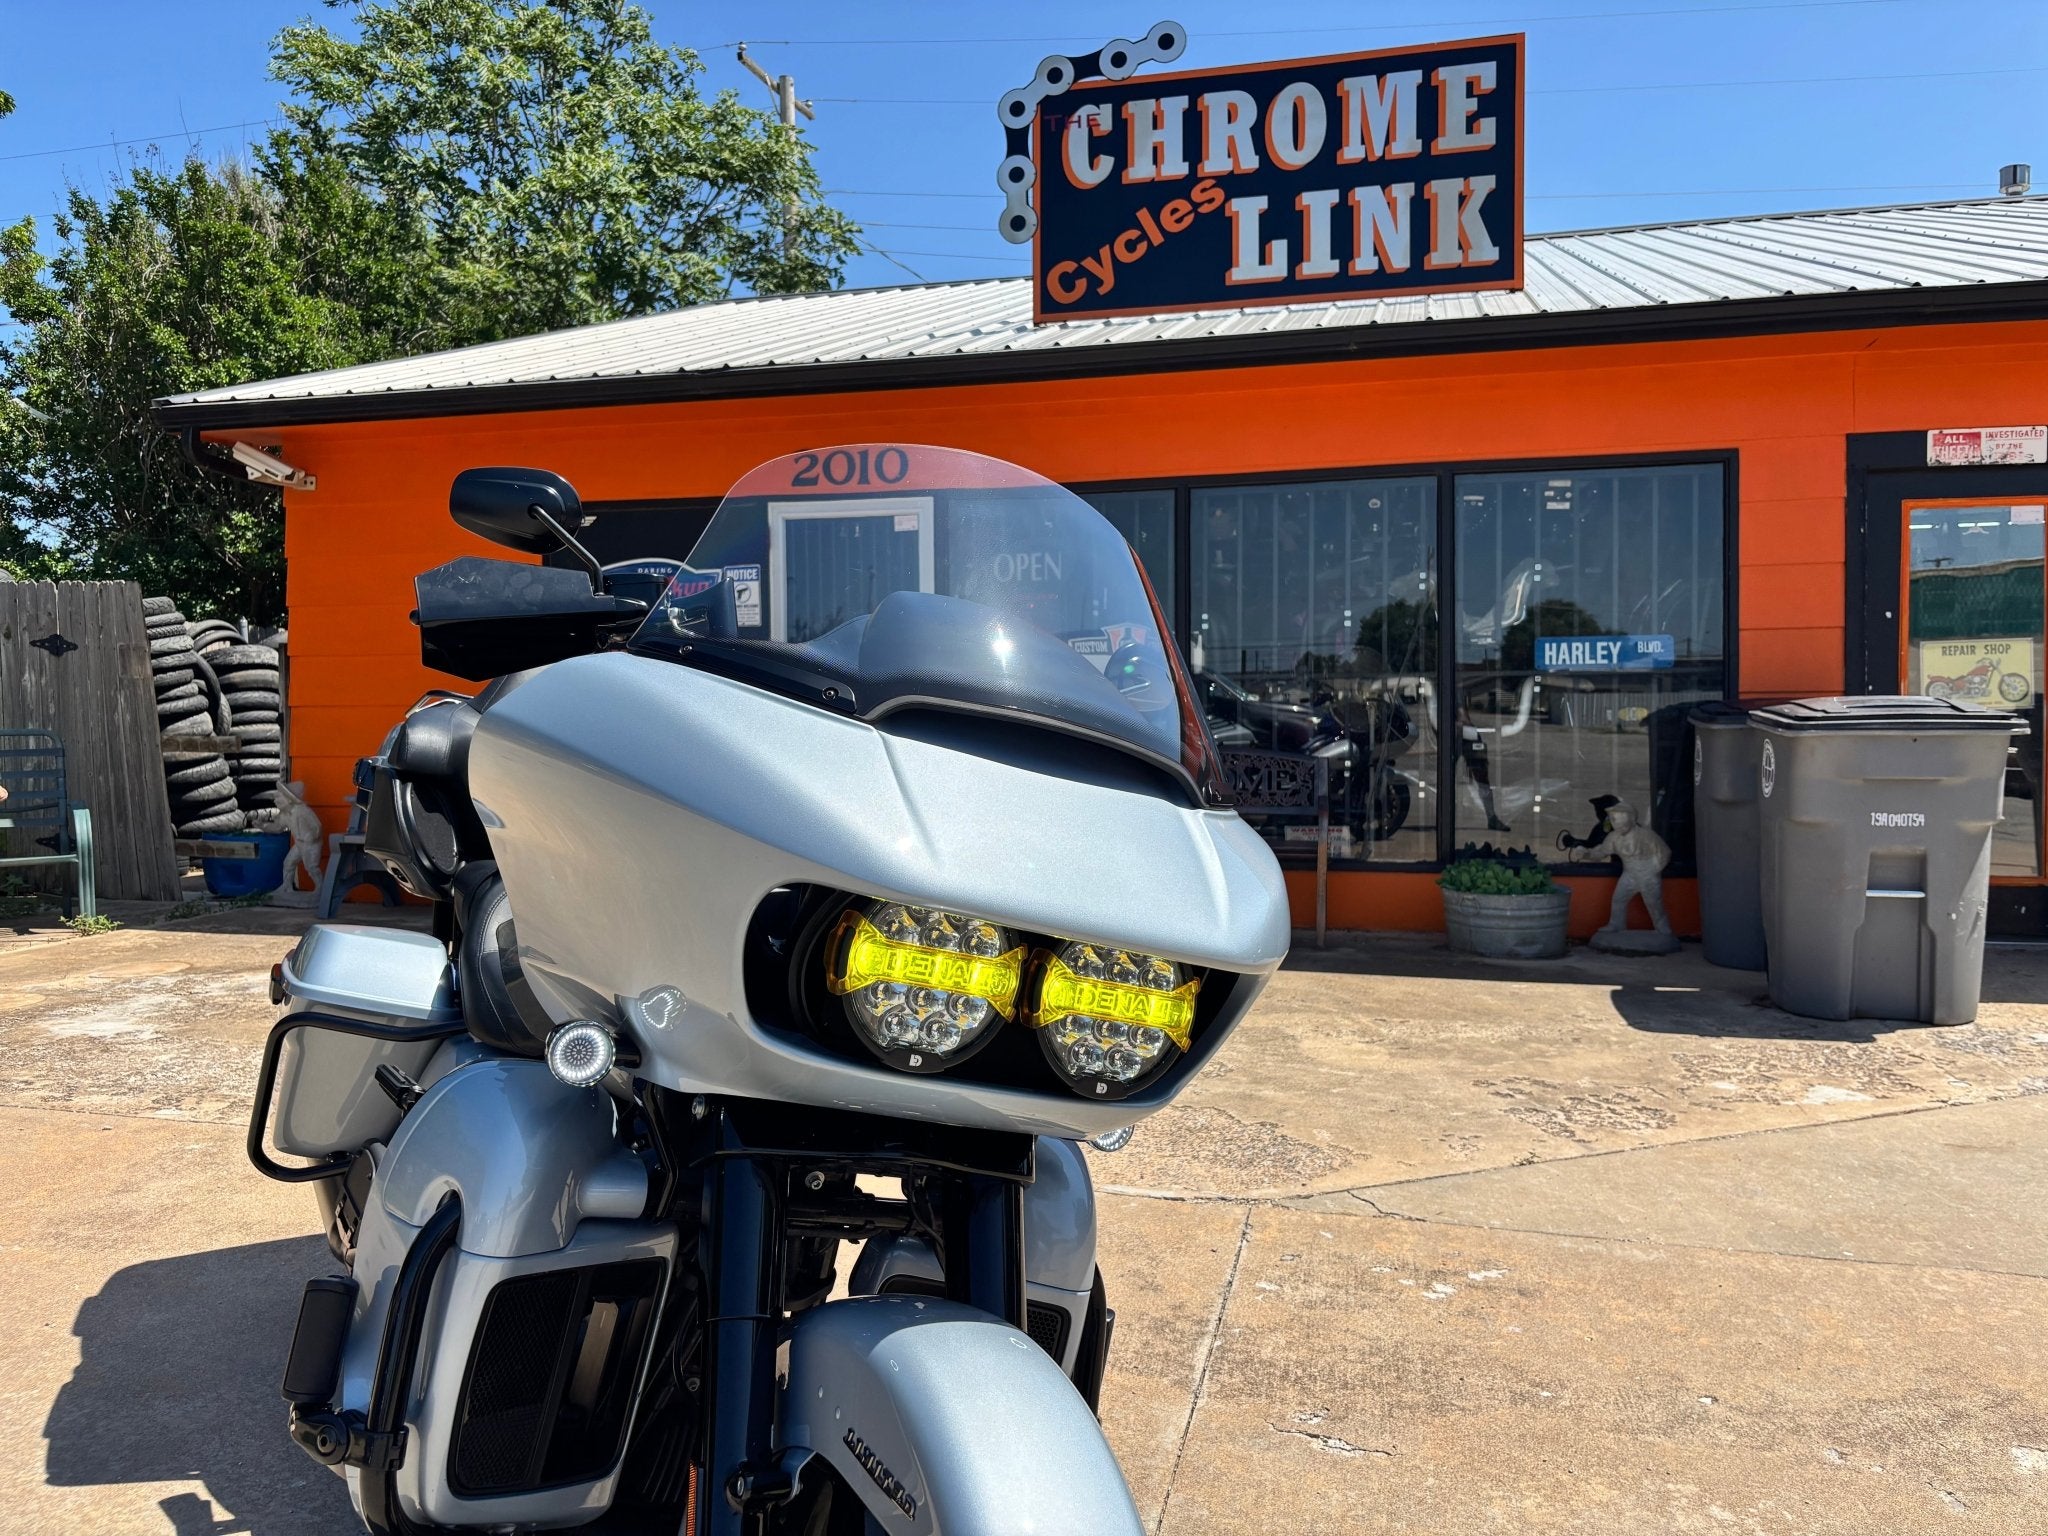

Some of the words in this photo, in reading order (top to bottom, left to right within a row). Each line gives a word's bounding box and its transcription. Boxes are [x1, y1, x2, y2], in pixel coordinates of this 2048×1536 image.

[1043, 113, 1101, 132] THE
[1062, 60, 1497, 190] CHROME
[1224, 174, 1499, 286] LINK
[1046, 178, 1226, 305] Cycles
[1944, 435, 1966, 444] ALL
[1985, 429, 2045, 439] INVESTIGATED
[791, 447, 909, 487] 2010
[726, 568, 758, 580] NOTICE
[993, 552, 1062, 582] OPEN
[1074, 640, 1108, 653] CUSTOM
[1544, 641, 1622, 666] HARLEY
[1637, 640, 1664, 653] BLVD.
[1941, 645, 1976, 656] REPAIR
[1984, 643, 2011, 655] SHOP
